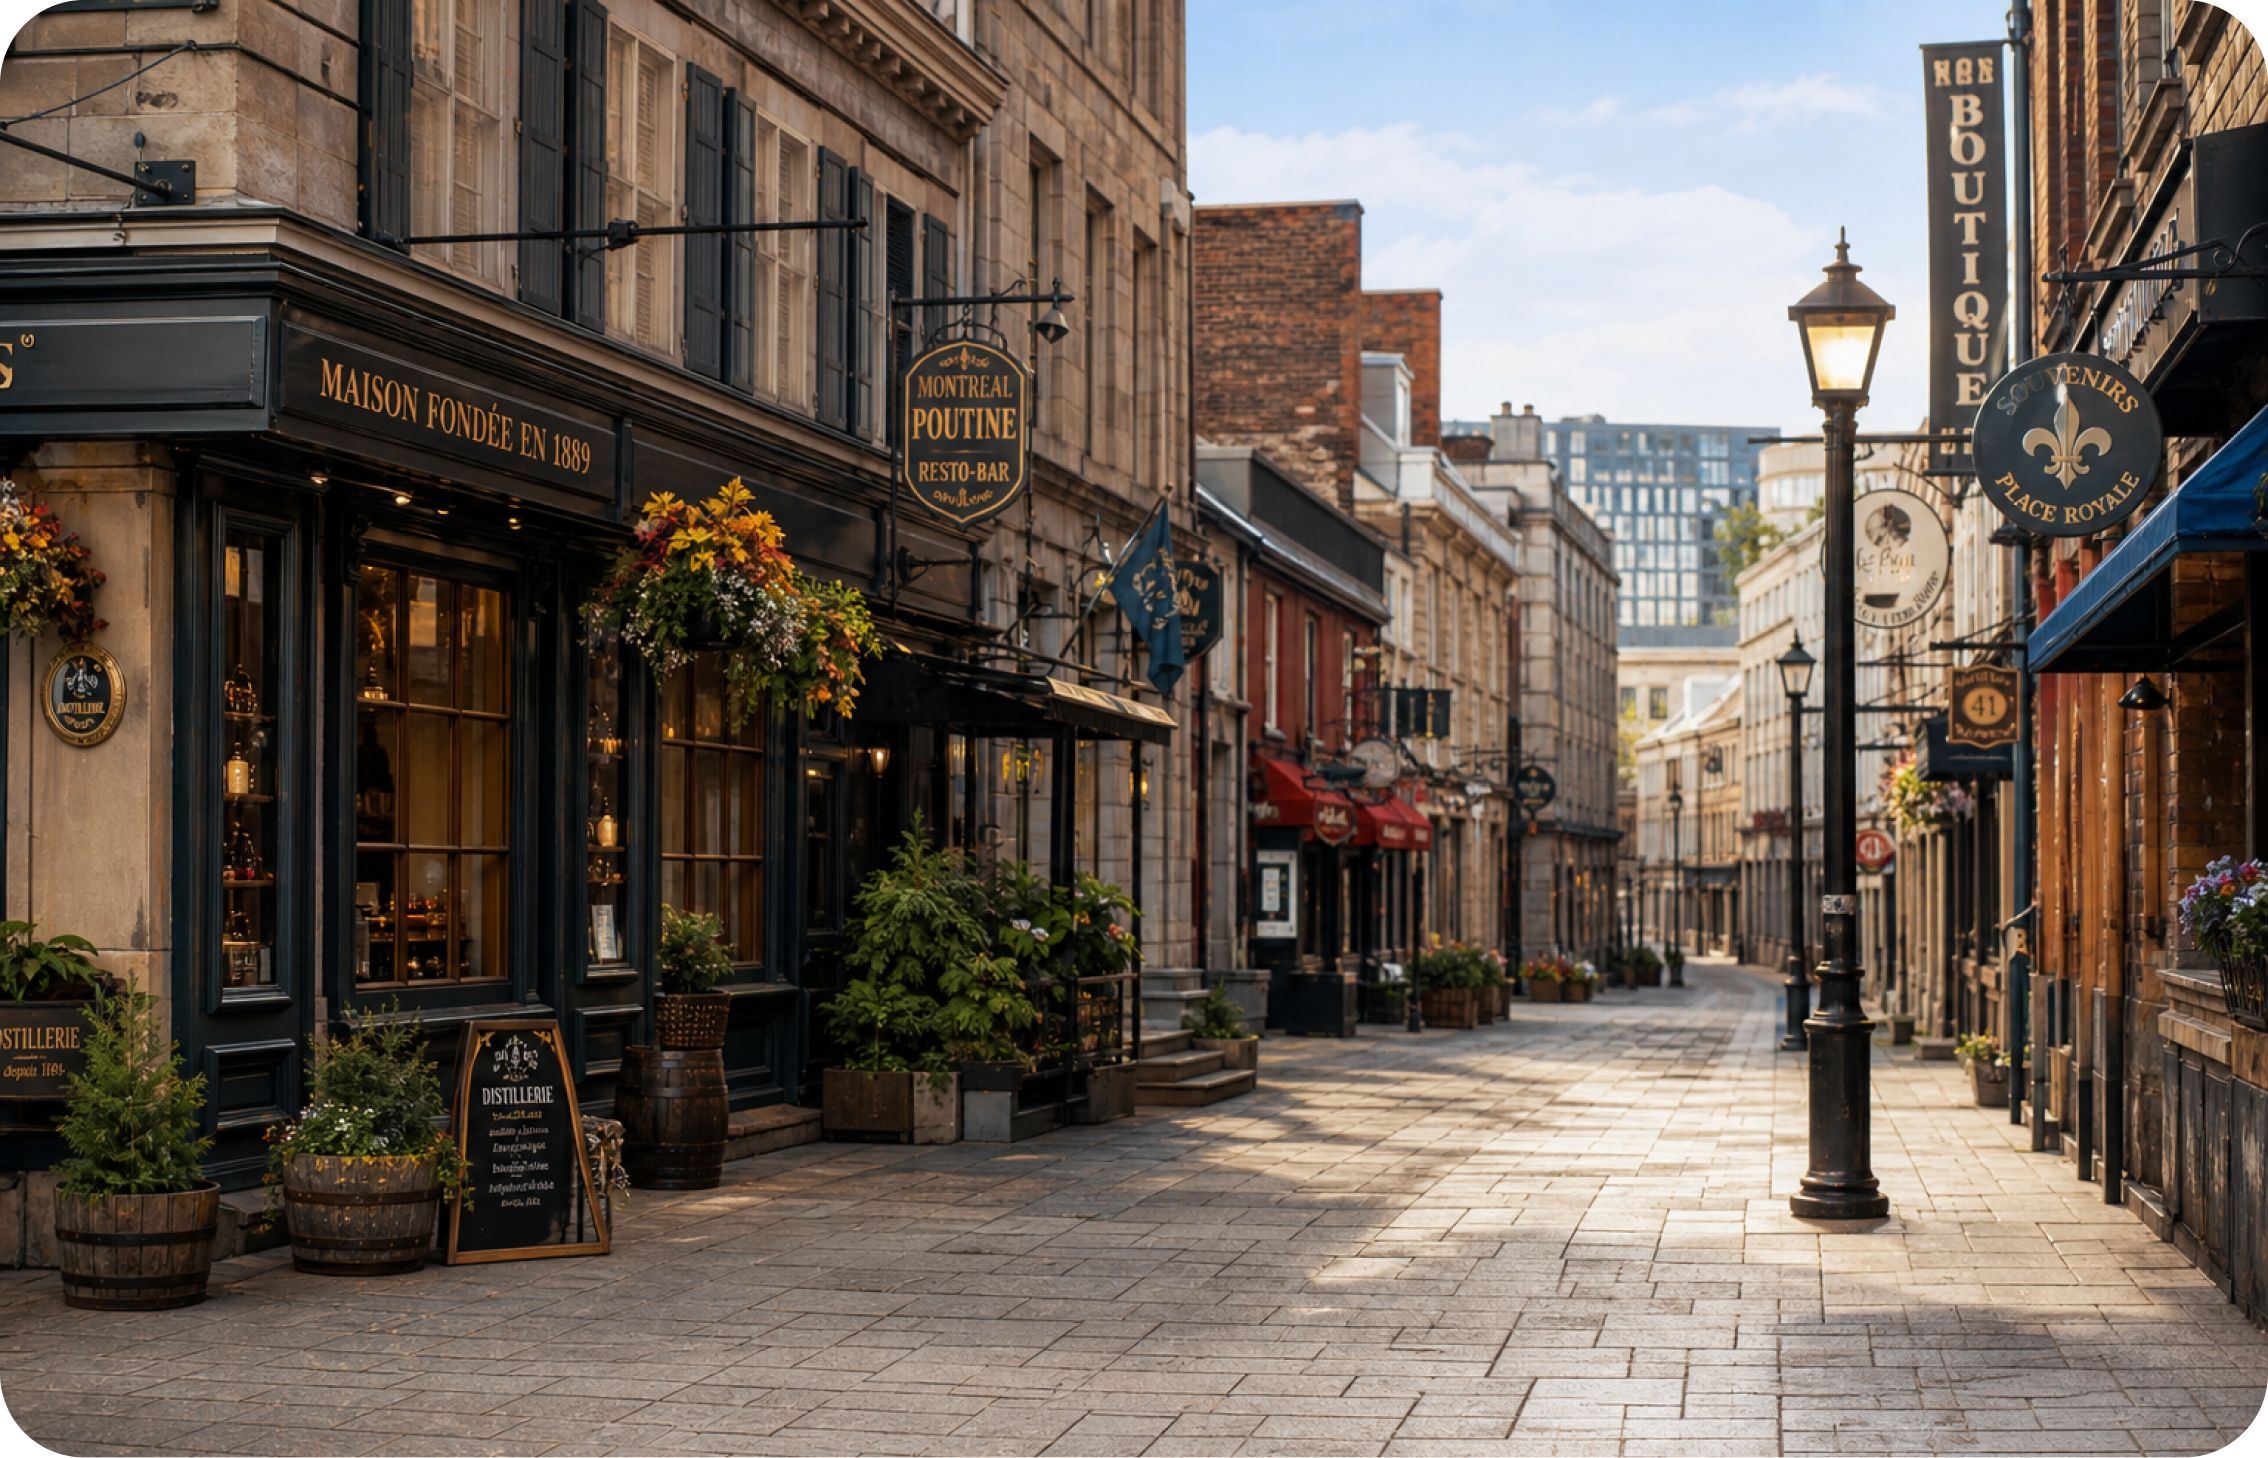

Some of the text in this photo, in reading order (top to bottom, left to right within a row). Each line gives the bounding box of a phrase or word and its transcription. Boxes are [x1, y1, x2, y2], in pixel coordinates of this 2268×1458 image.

[1949, 94, 1989, 406] BOUTIQUE
[917, 374, 1013, 398] MONTREAL
[1996, 363, 2139, 416] SOUVENIRS
[320, 358, 591, 475] MAISON FONDÉE EN 1889
[911, 406, 1017, 440] POUTINE
[918, 461, 1010, 483] RESTO-BAR
[1995, 471, 2140, 524] PLACE ROYALE
[1970, 693, 1997, 717] 41
[0, 1027, 80, 1050] STILLERIE
[482, 1085, 555, 1106] DISTILLERIE
